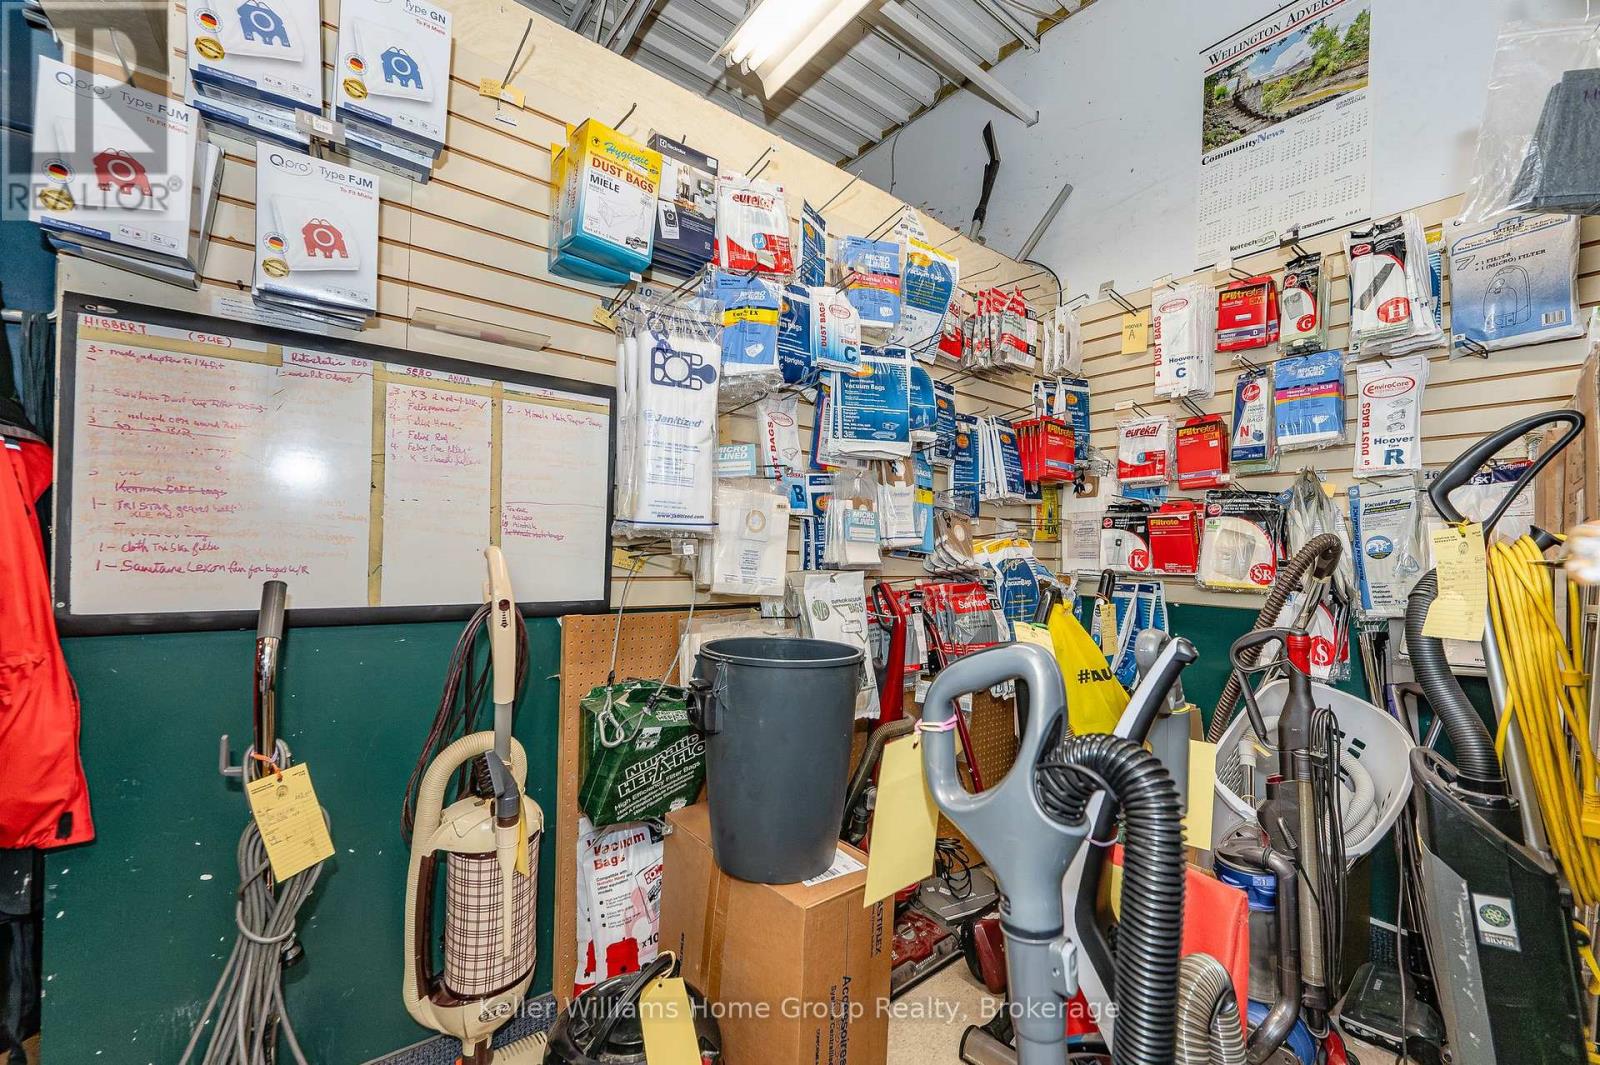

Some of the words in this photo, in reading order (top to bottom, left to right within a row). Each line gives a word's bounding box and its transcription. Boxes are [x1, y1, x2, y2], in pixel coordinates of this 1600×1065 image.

[430, 10, 447, 25] GN
[1208, 22, 1282, 66] WELLINGTON
[55, 71, 109, 98] Qpro
[120, 91, 153, 111] Type
[158, 104, 190, 122] FJM
[604, 141, 649, 166] Hygienic
[269, 153, 311, 173] Qpro
[319, 166, 346, 181] Type
[348, 175, 373, 189] FJM
[592, 157, 623, 178] DUST
[626, 172, 654, 194] BAGS
[590, 174, 620, 194] MIELE
[864, 253, 891, 263] MICRO
[1486, 252, 1512, 265] FILTER
[1518, 249, 1547, 261] FILTER
[639, 288, 653, 297] 10
[819, 302, 828, 323] BAGS
[1388, 302, 1405, 319] H
[1154, 315, 1162, 341] BAGS
[1302, 319, 1312, 329] G
[818, 325, 827, 348] DUST
[1128, 329, 1136, 341] A
[844, 346, 857, 362] C
[1154, 343, 1163, 367] DUST
[1352, 343, 1359, 351] 5
[1169, 355, 1194, 364] Hoover
[1175, 366, 1187, 379] C
[1298, 364, 1326, 374] MICRO
[870, 384, 886, 392] Bags
[654, 413, 704, 429] Janitized
[1362, 402, 1371, 427] BAGS
[768, 421, 778, 452] BAGS
[1125, 424, 1162, 438] eureka!
[1239, 425, 1250, 437] N
[1362, 431, 1370, 456] DUST
[1373, 436, 1415, 445] Hoover
[718, 452, 748, 460] LINED
[1384, 449, 1406, 466] R
[1498, 463, 1527, 471] Original
[791, 484, 805, 503] B
[1133, 555, 1145, 568] K
[1253, 568, 1273, 581] SR
[1313, 642, 1329, 664] S
[624, 733, 699, 780] Numatic
[617, 741, 706, 798] HEPA-FLO
[614, 798, 631, 811] High
[632, 782, 664, 801] Efficiency
[665, 771, 682, 781] Filter
[683, 761, 701, 773] Bags
[593, 831, 646, 857] Vacuum
[593, 854, 626, 871] Bags
[875, 900, 884, 953] ASTIFLEX
[641, 931, 659, 949] x10
